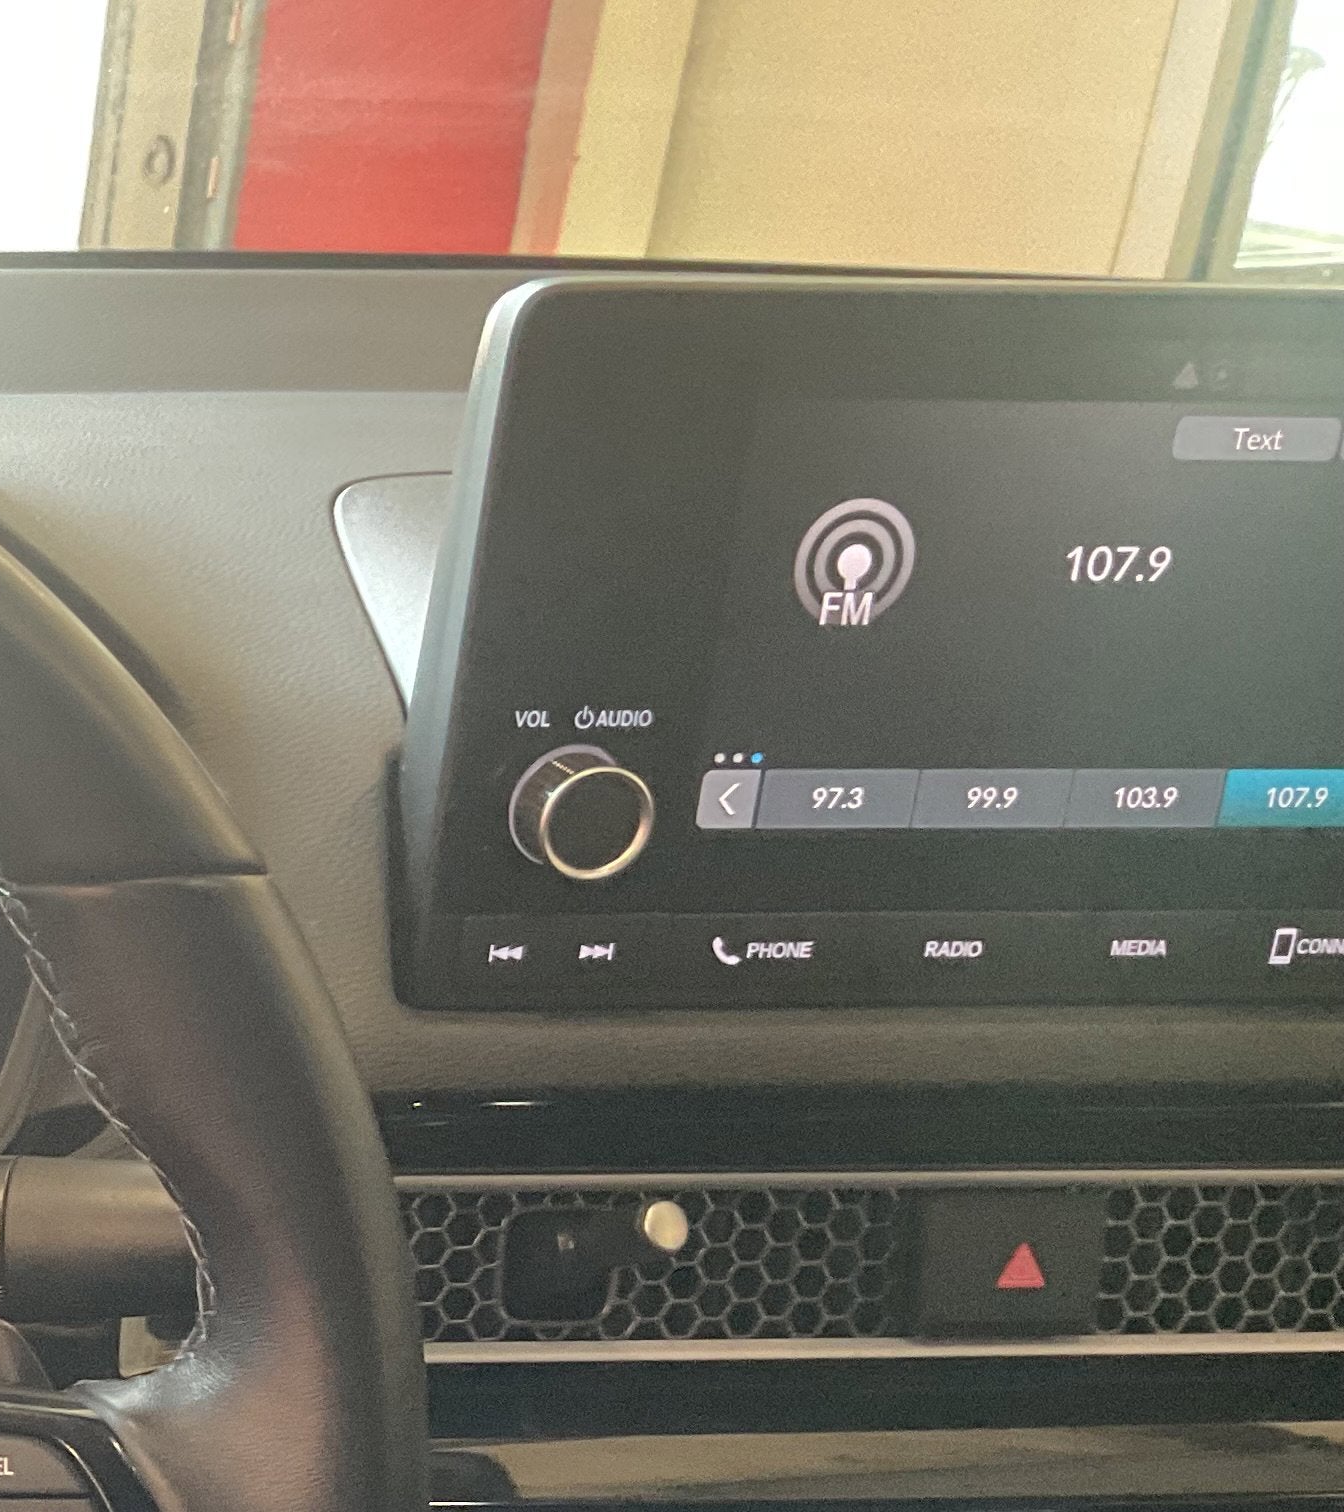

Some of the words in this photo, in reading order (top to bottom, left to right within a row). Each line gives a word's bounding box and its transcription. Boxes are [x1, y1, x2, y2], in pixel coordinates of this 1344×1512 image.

[1233, 427, 1284, 451] Text
[1065, 544, 1174, 584] 107.9
[819, 594, 874, 627] FM
[515, 709, 551, 728] VOL
[595, 709, 653, 727] AUDIO
[811, 787, 865, 812] 97.3
[966, 787, 1020, 812] 99.9
[1113, 786, 1179, 811] 103.9
[1265, 785, 1330, 810] 107.9
[747, 940, 814, 962] PHONE
[924, 939, 983, 961] RADIO
[1110, 939, 1168, 960] MEDIA
